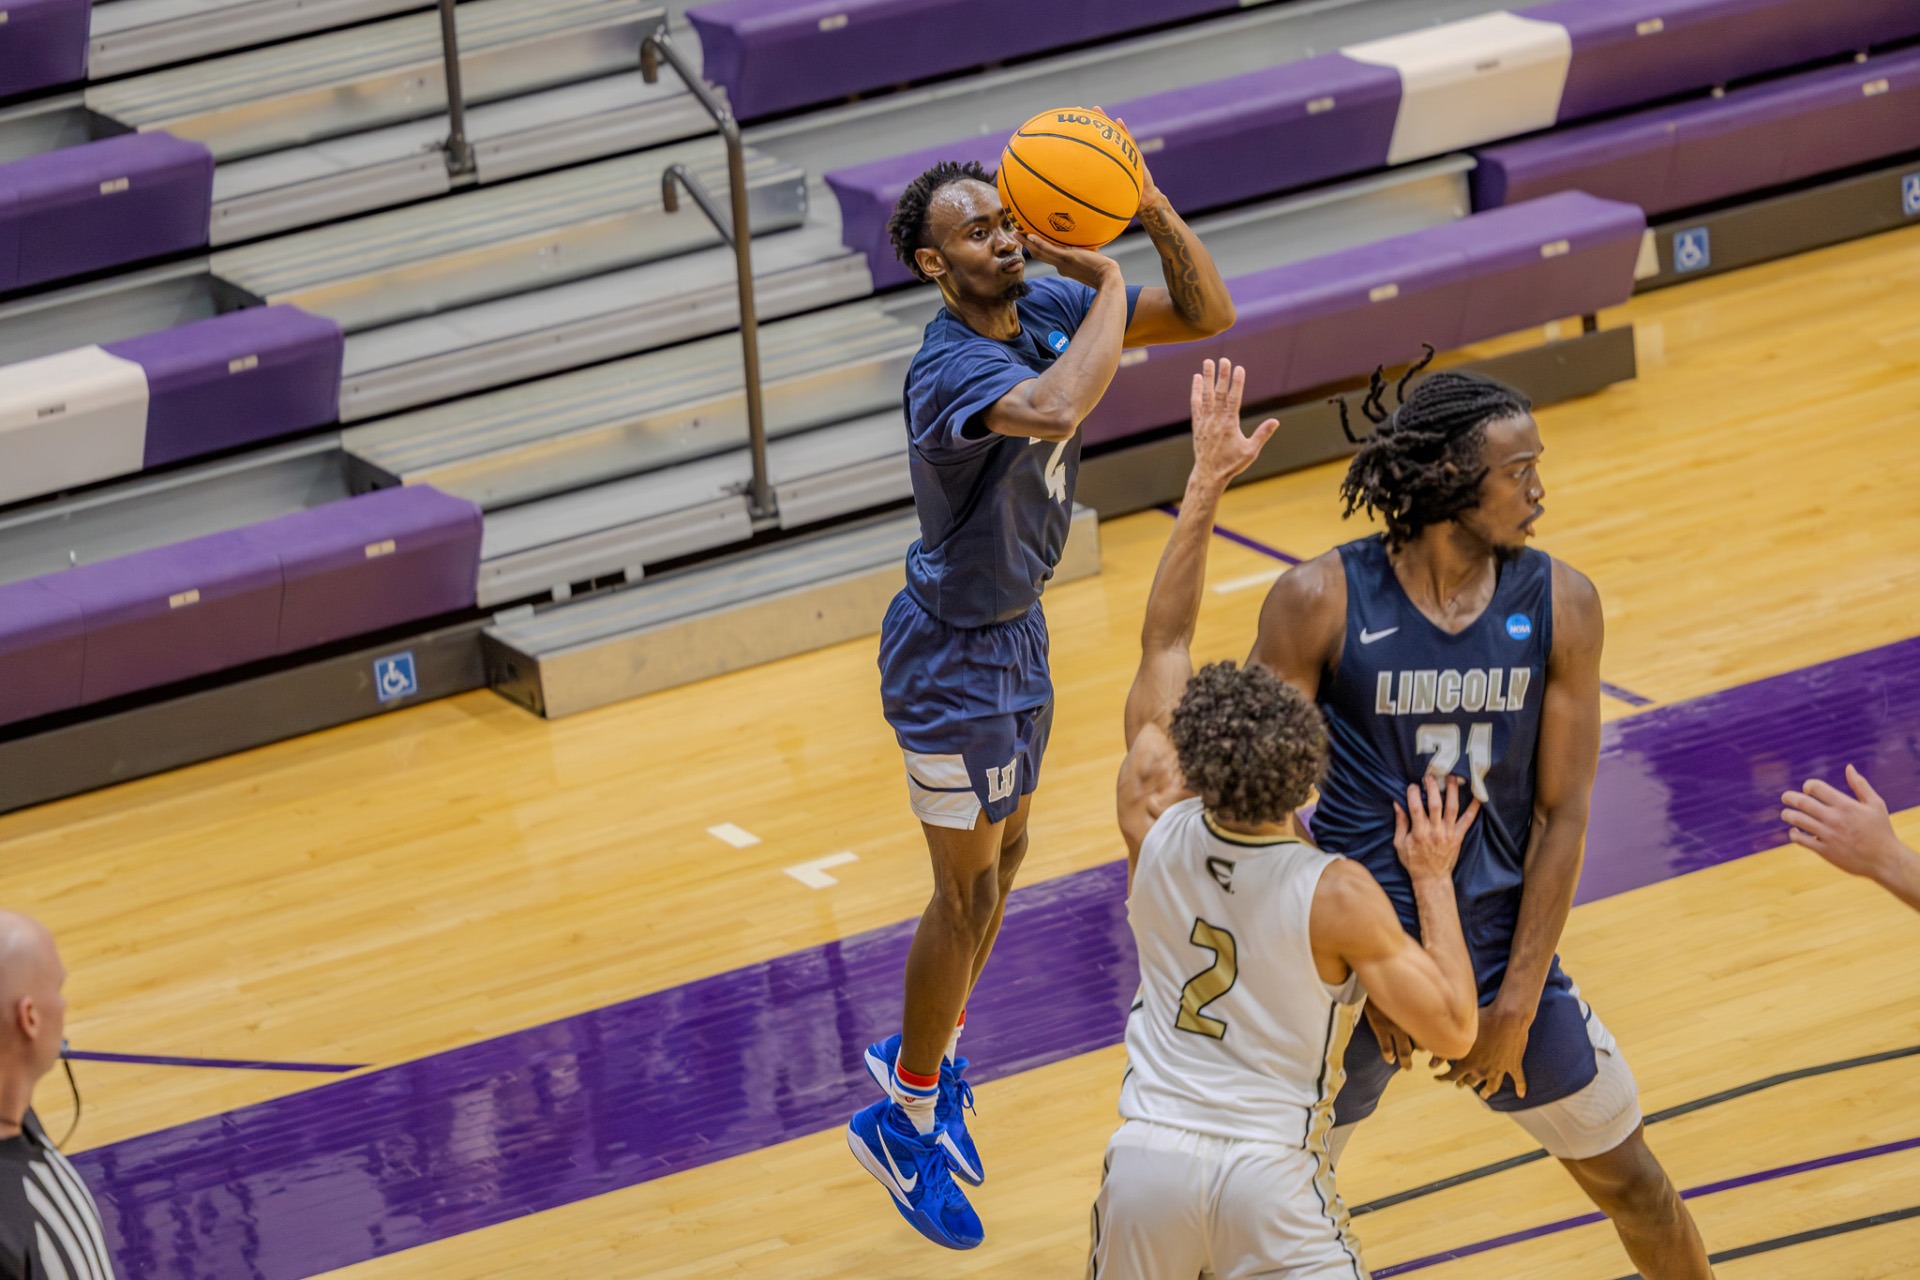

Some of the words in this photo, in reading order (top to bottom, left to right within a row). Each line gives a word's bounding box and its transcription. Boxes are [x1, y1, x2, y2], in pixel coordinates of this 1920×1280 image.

[1056, 113, 1138, 171] Wilson
[1375, 667, 1531, 715] LINCOLN
[985, 757, 1017, 803] LU
[1416, 722, 1492, 803] 21
[1174, 916, 1238, 1040] 2
